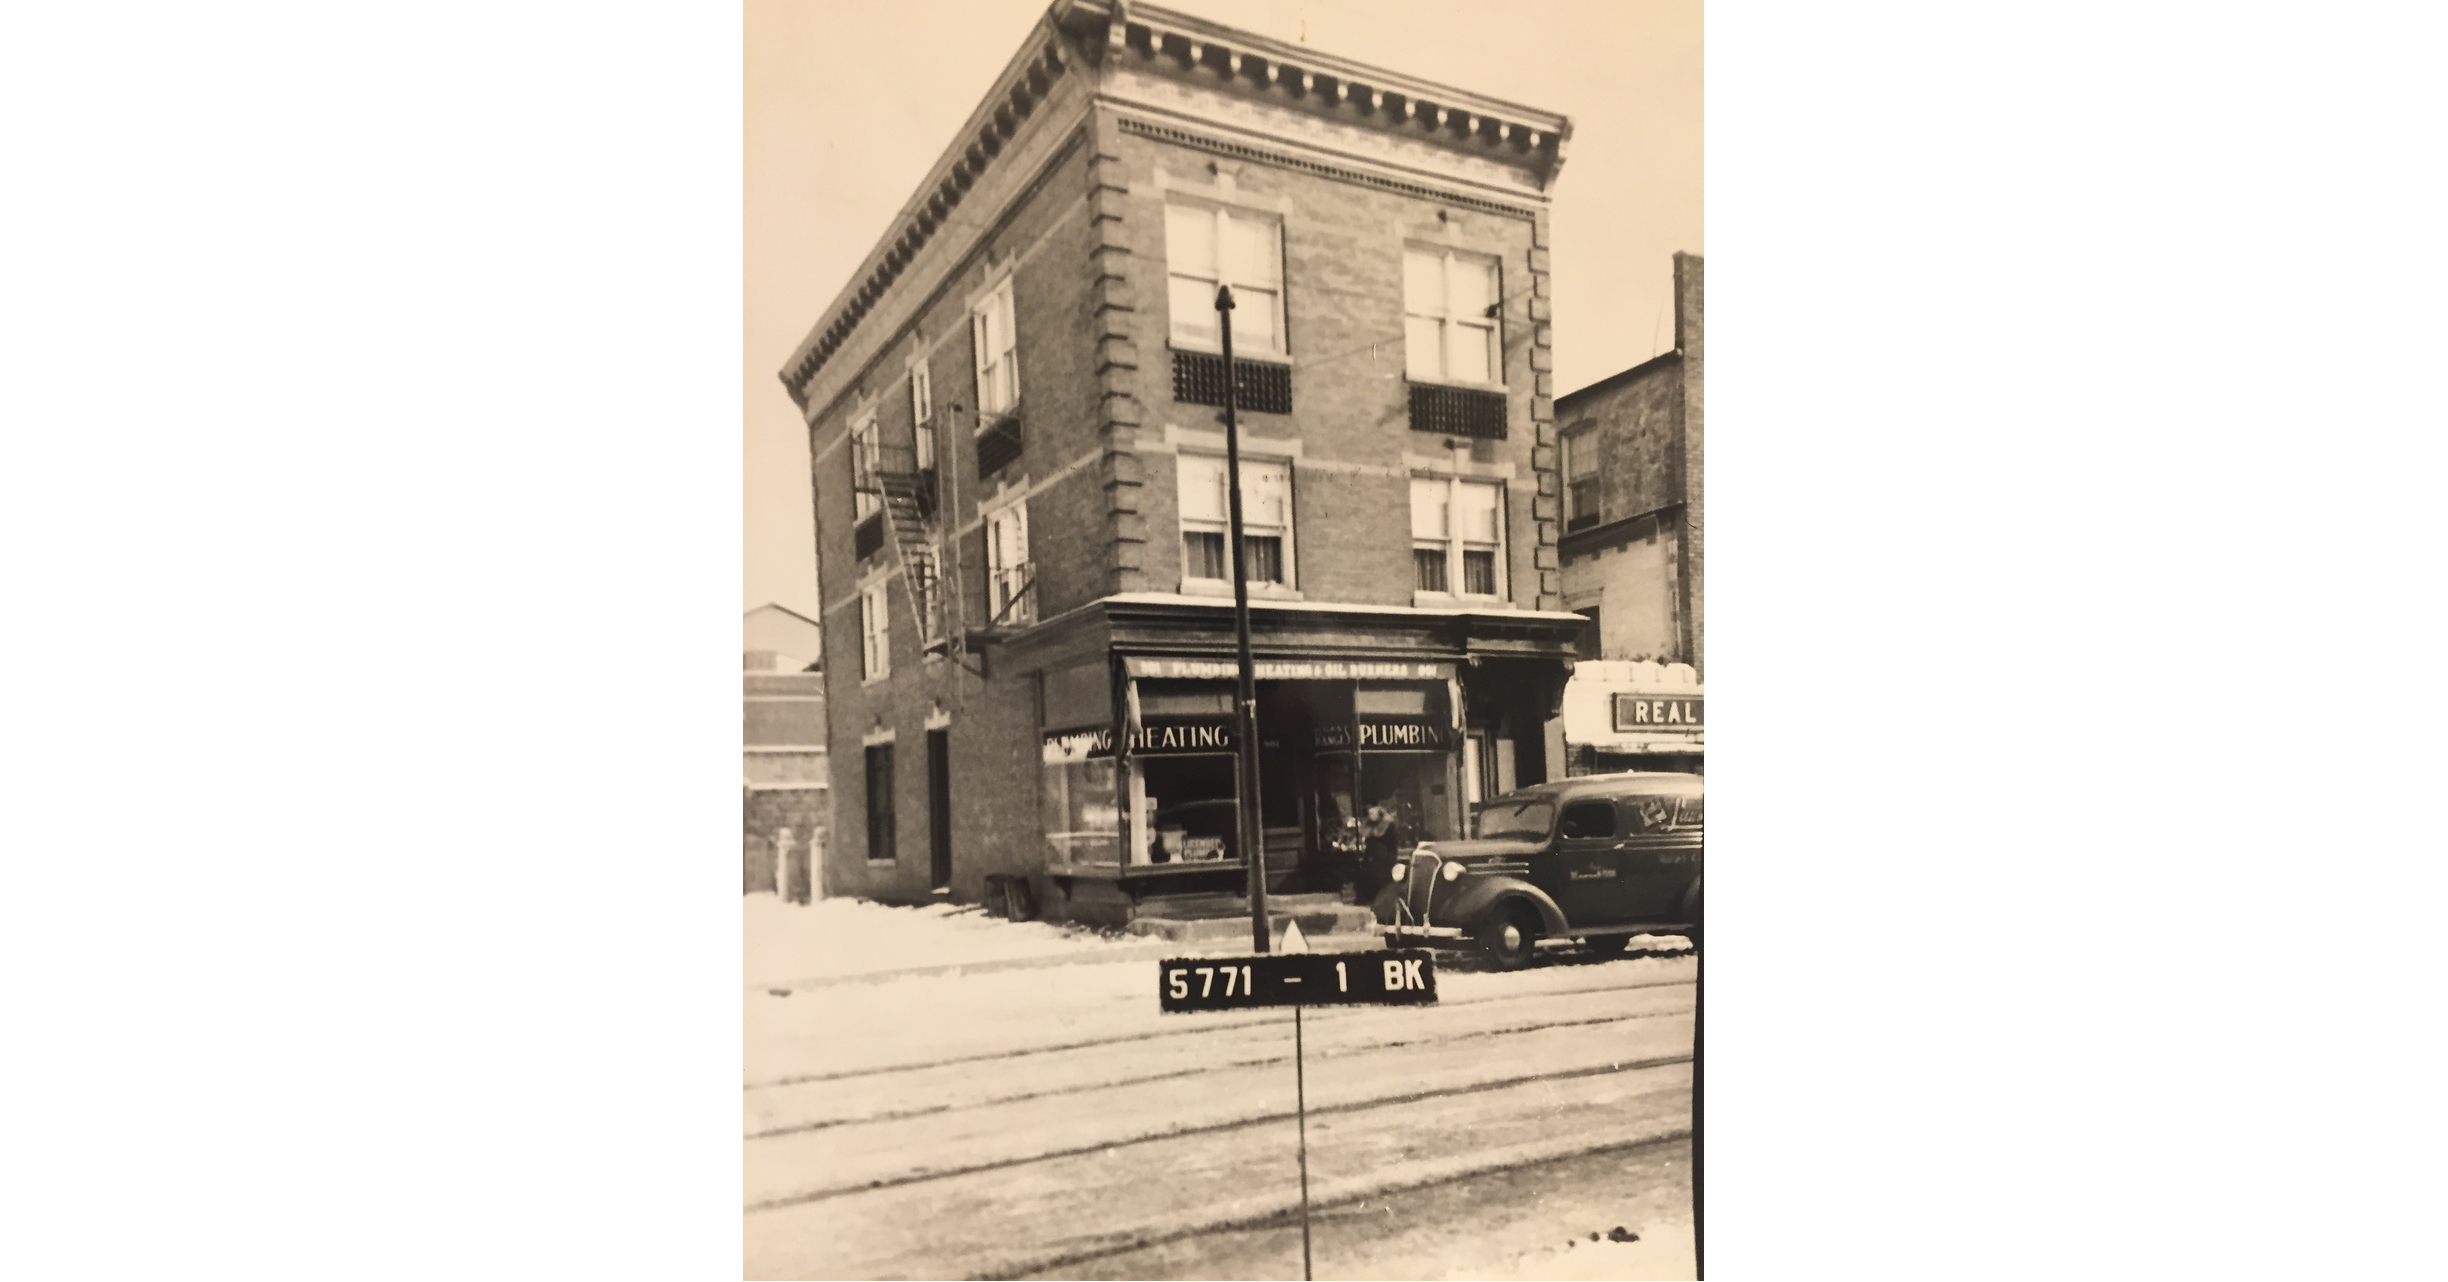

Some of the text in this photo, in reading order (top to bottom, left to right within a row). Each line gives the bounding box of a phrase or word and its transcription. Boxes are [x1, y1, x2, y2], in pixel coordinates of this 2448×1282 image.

[1254, 663, 1312, 677] HEATING
[1324, 664, 1347, 677] OIL
[1350, 664, 1408, 677] BURNERS
[1635, 701, 1697, 723] REAL
[1129, 726, 1229, 749] HEATING
[1169, 965, 1252, 999] 5771
[1336, 961, 1348, 992] 1
[1383, 959, 1426, 990] BK
